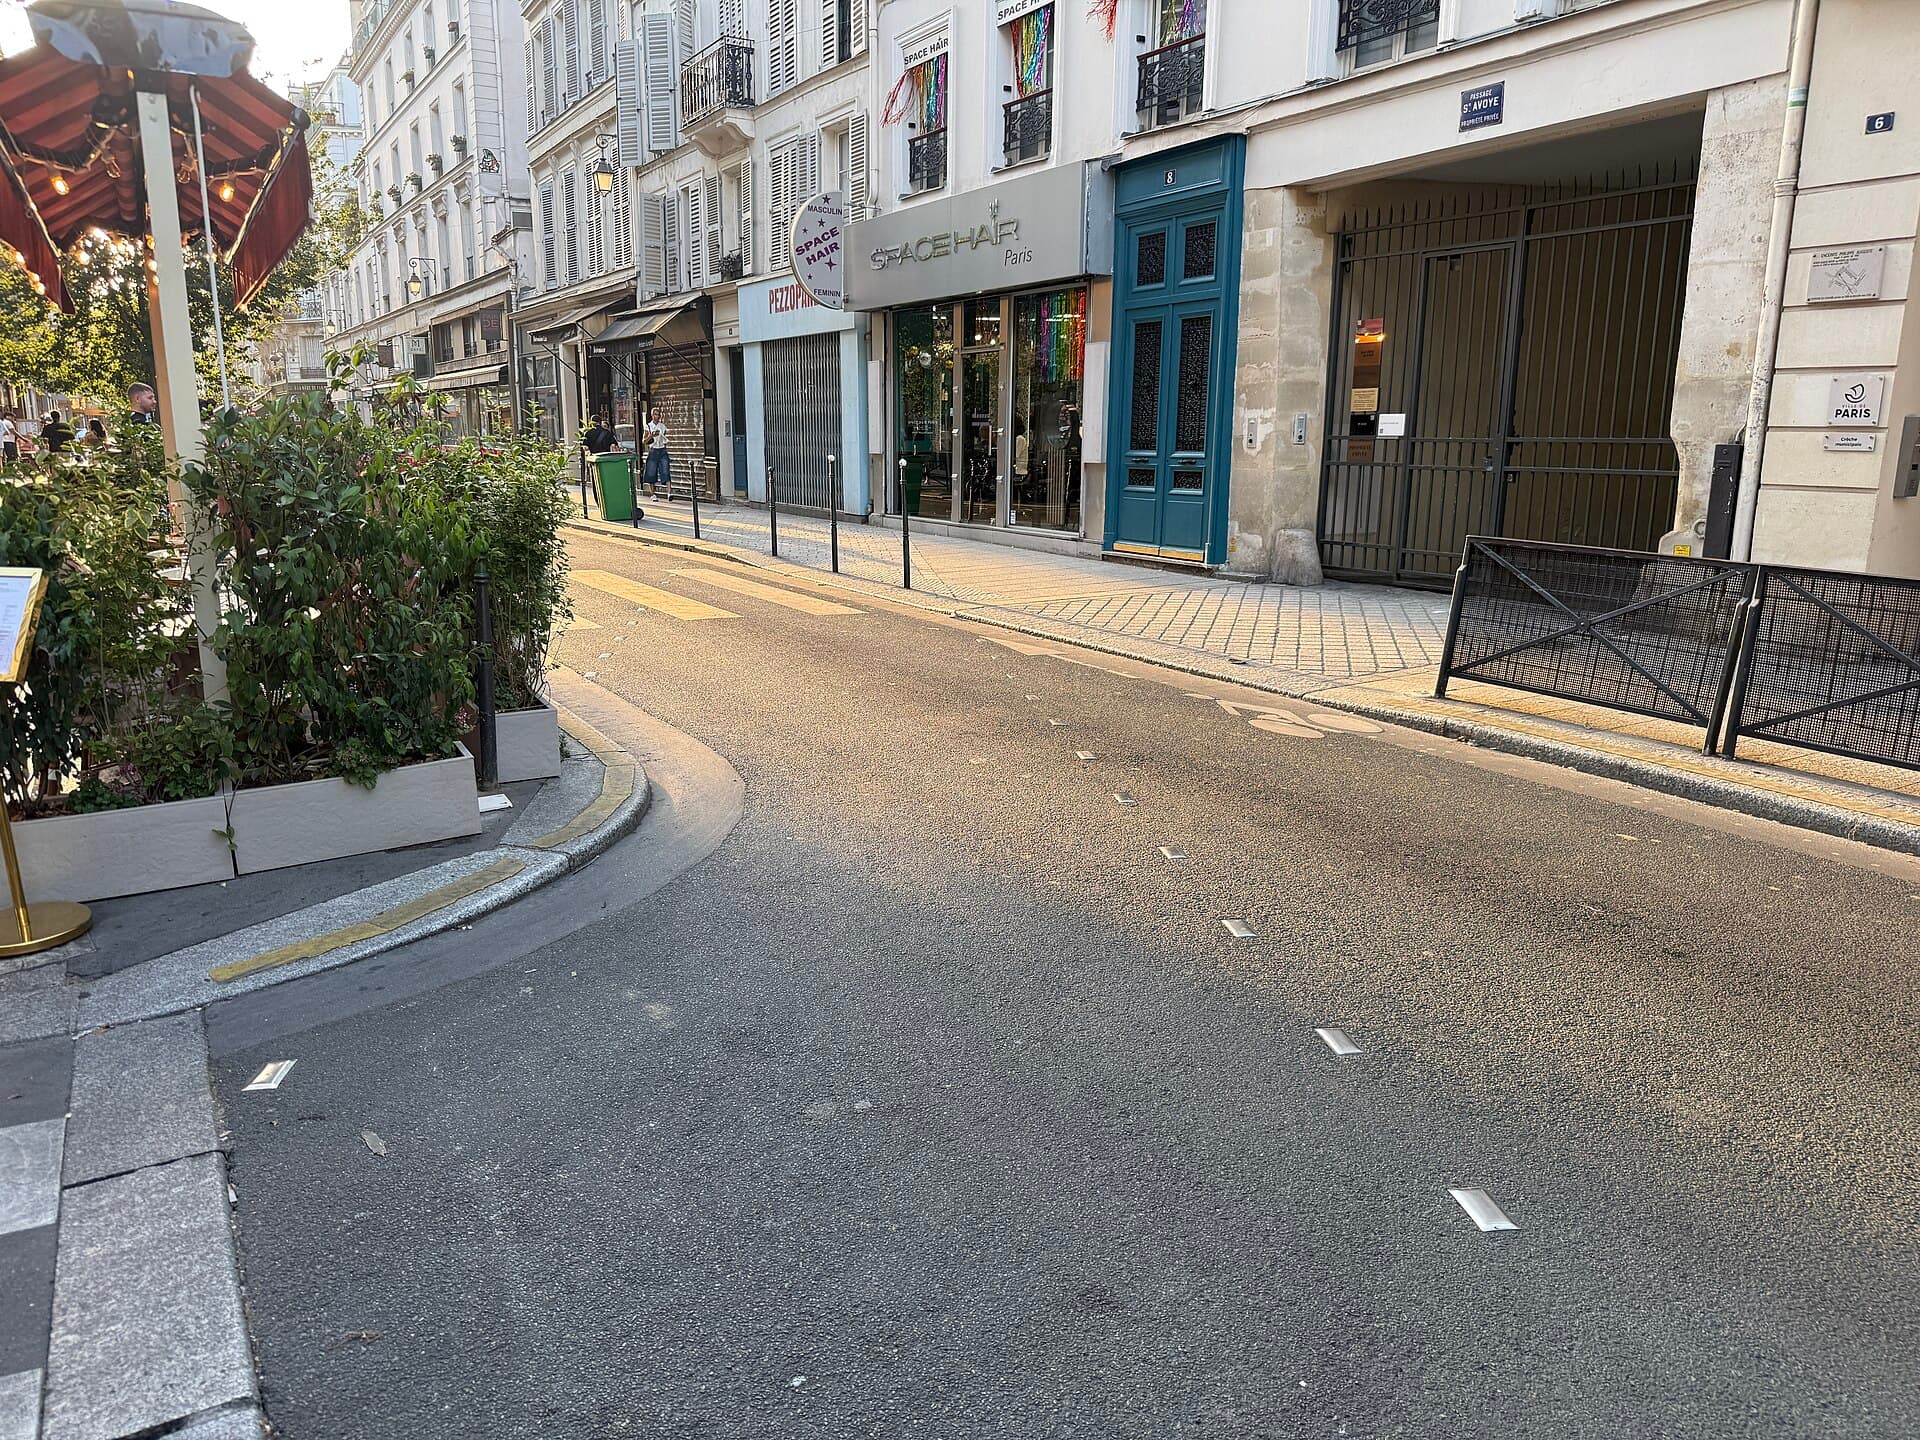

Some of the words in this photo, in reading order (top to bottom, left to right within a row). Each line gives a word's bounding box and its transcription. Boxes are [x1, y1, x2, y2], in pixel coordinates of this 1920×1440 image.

[997, 0, 1028, 20] SPACE
[904, 47, 928, 65] SPACE
[929, 38, 949, 53] HAIR
[1470, 89, 1492, 100] PASSAGE
[1473, 96, 1499, 111] AVOYE
[1875, 116, 1884, 129] 6
[1167, 171, 1173, 183] 8
[807, 205, 842, 215] MASCULIN
[795, 226, 840, 256] SPACE
[870, 231, 951, 271] SPACE
[953, 206, 1019, 254] HAIR
[805, 242, 841, 265] HAIR
[1004, 246, 1033, 267] Paris
[813, 288, 841, 298] FEMININ
[1834, 408, 1871, 418] PARIS
